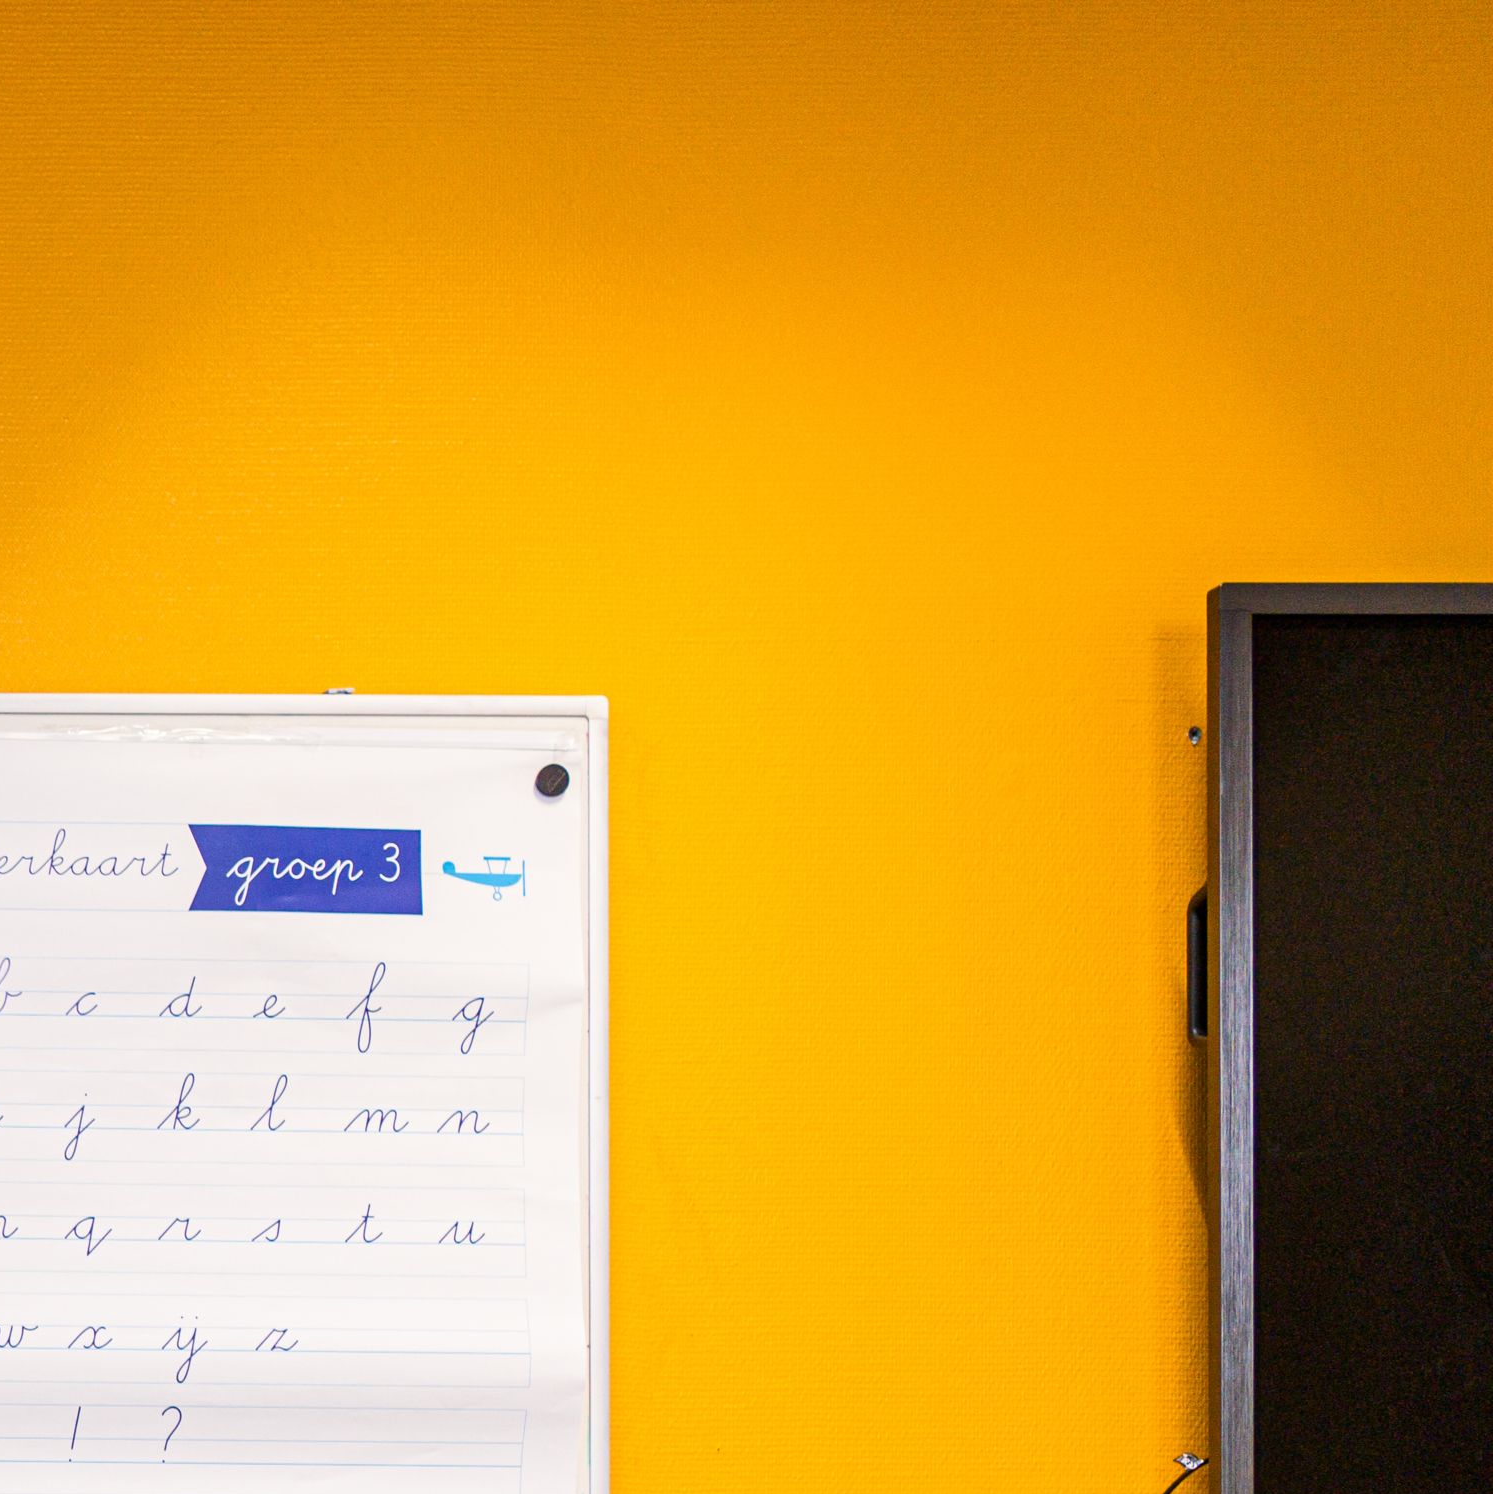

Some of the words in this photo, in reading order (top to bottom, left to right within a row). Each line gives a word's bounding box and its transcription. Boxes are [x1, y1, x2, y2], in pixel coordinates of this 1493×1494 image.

[225, 852, 364, 907] groep
[379, 842, 402, 883] 3
[65, 991, 98, 1017] c
[159, 976, 203, 1018] d
[253, 994, 286, 1019] e
[346, 961, 387, 1054] f
[452, 996, 495, 1055] g
[65, 1093, 97, 1161] j
[157, 1072, 201, 1131] k
[250, 1073, 288, 1132] l
[344, 1108, 409, 1133] m
[437, 1109, 490, 1135] n
[65, 1215, 113, 1257] q
[158, 1217, 202, 1242] r
[252, 1218, 282, 1243] s
[345, 1203, 383, 1244] t
[439, 1220, 486, 1245] u
[68, 1325, 113, 1350] x
[256, 1328, 299, 1352] z
[69, 1405, 82, 1463] !
[161, 1405, 183, 1463] ?
